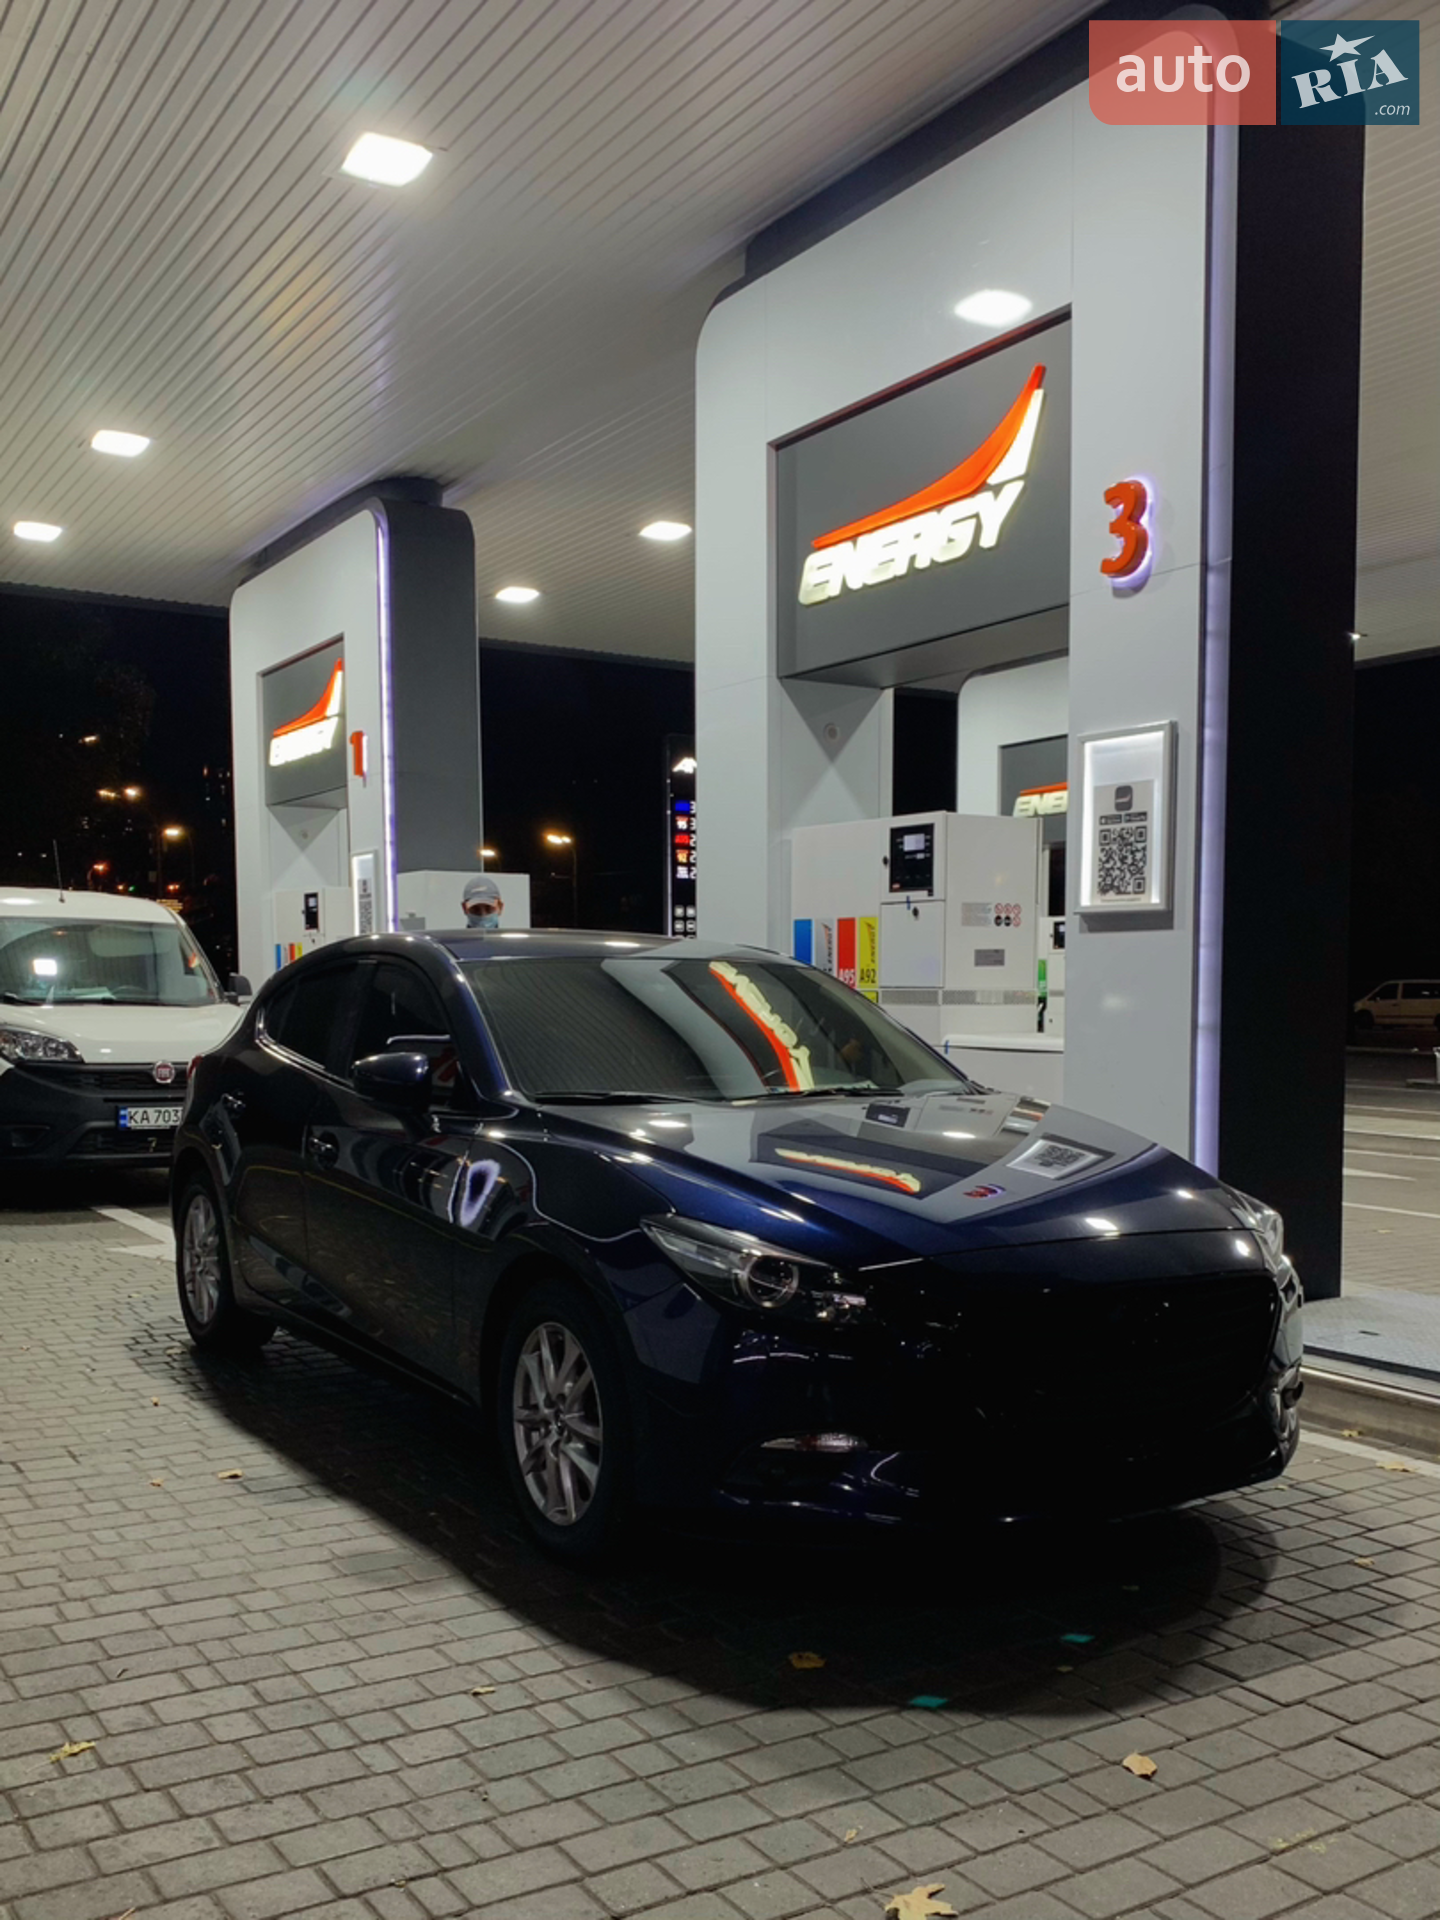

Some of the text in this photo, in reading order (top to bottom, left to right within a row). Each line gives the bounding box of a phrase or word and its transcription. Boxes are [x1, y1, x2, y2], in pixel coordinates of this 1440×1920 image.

[798, 479, 1025, 607] ENERGY
[1099, 478, 1151, 580] 3
[1013, 790, 1069, 818] ENE
[859, 968, 877, 984] A92
[128, 1109, 184, 1124] KA 703
